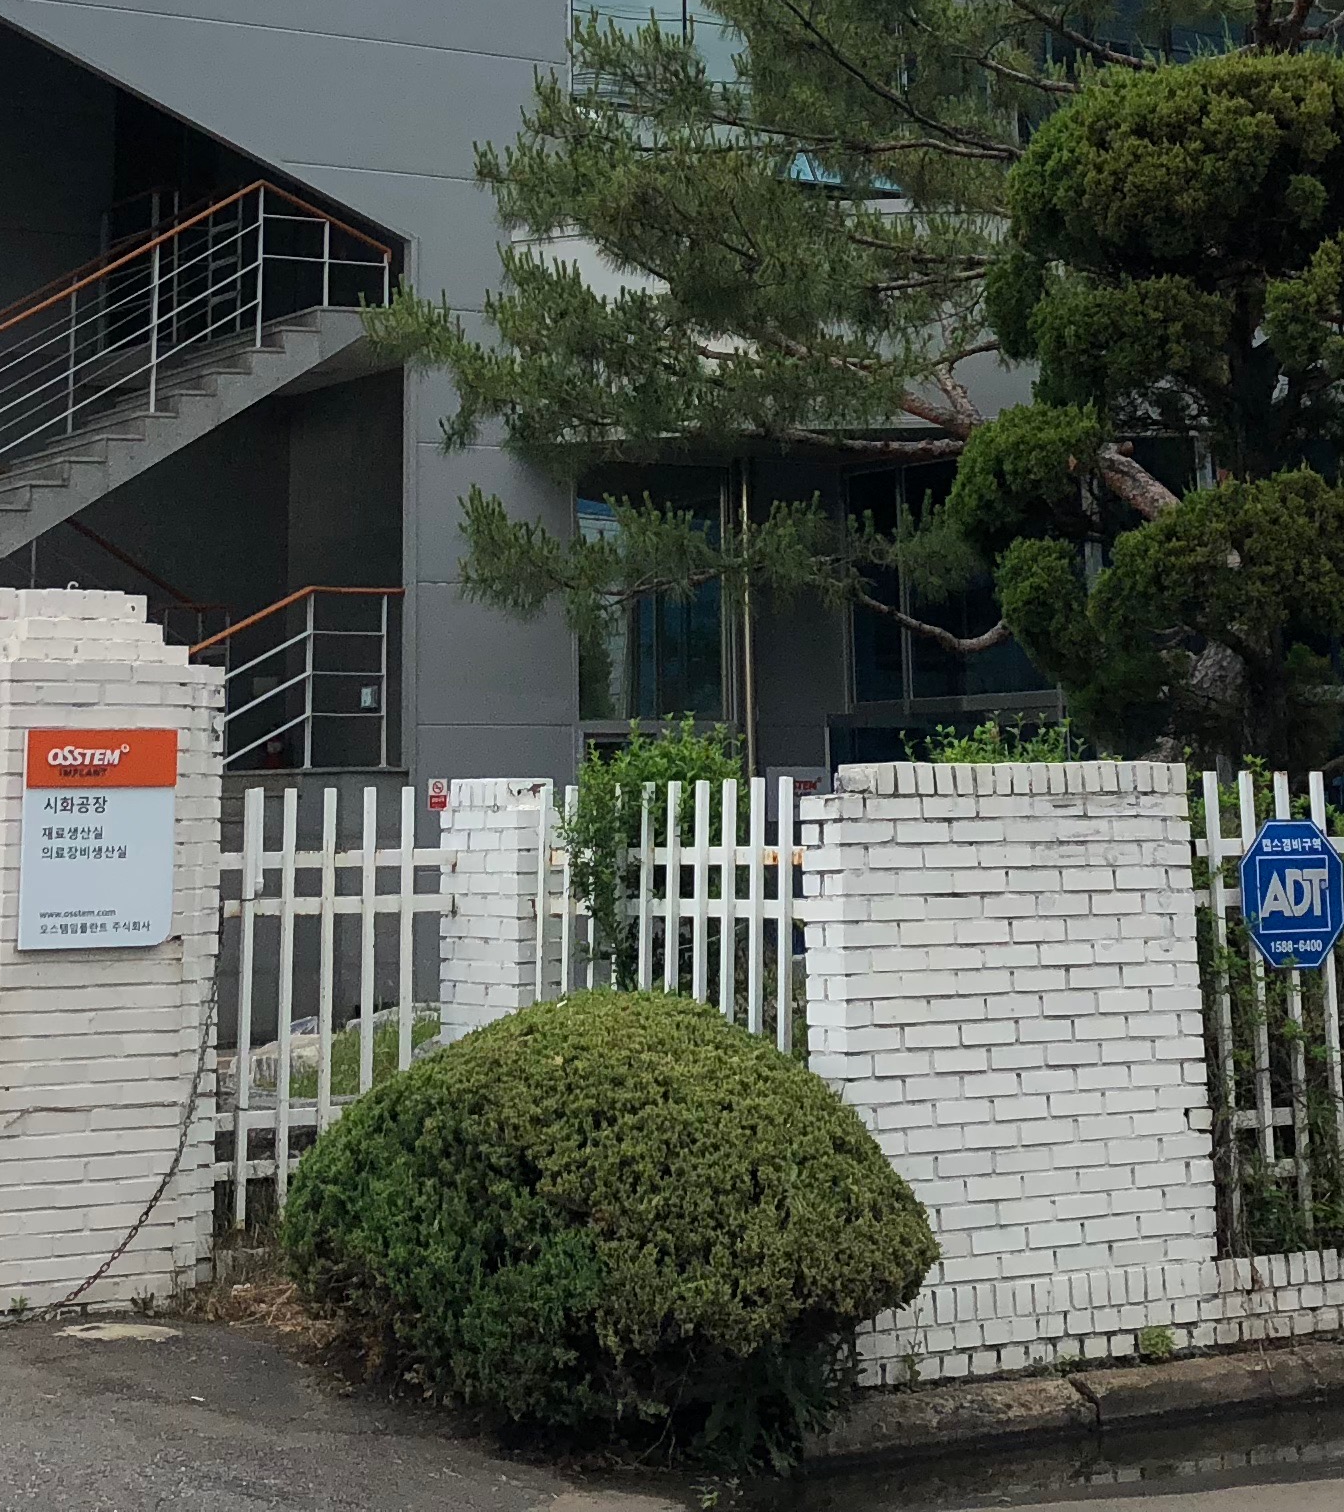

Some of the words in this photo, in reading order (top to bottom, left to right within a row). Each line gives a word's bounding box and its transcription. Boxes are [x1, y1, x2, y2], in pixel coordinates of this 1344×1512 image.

[47, 745, 120, 766] OSSTEM
[59, 768, 108, 778] IMPLANT
[44, 795, 108, 814] 시화공장
[42, 825, 104, 840] 재료생산실
[42, 845, 127, 860] 의료장비생산실
[1260, 868, 1328, 918] ADT
[39, 909, 117, 919] www.osstem.com
[112, 920, 151, 932] 주식회사
[1270, 939, 1323, 953] 1588-6400
